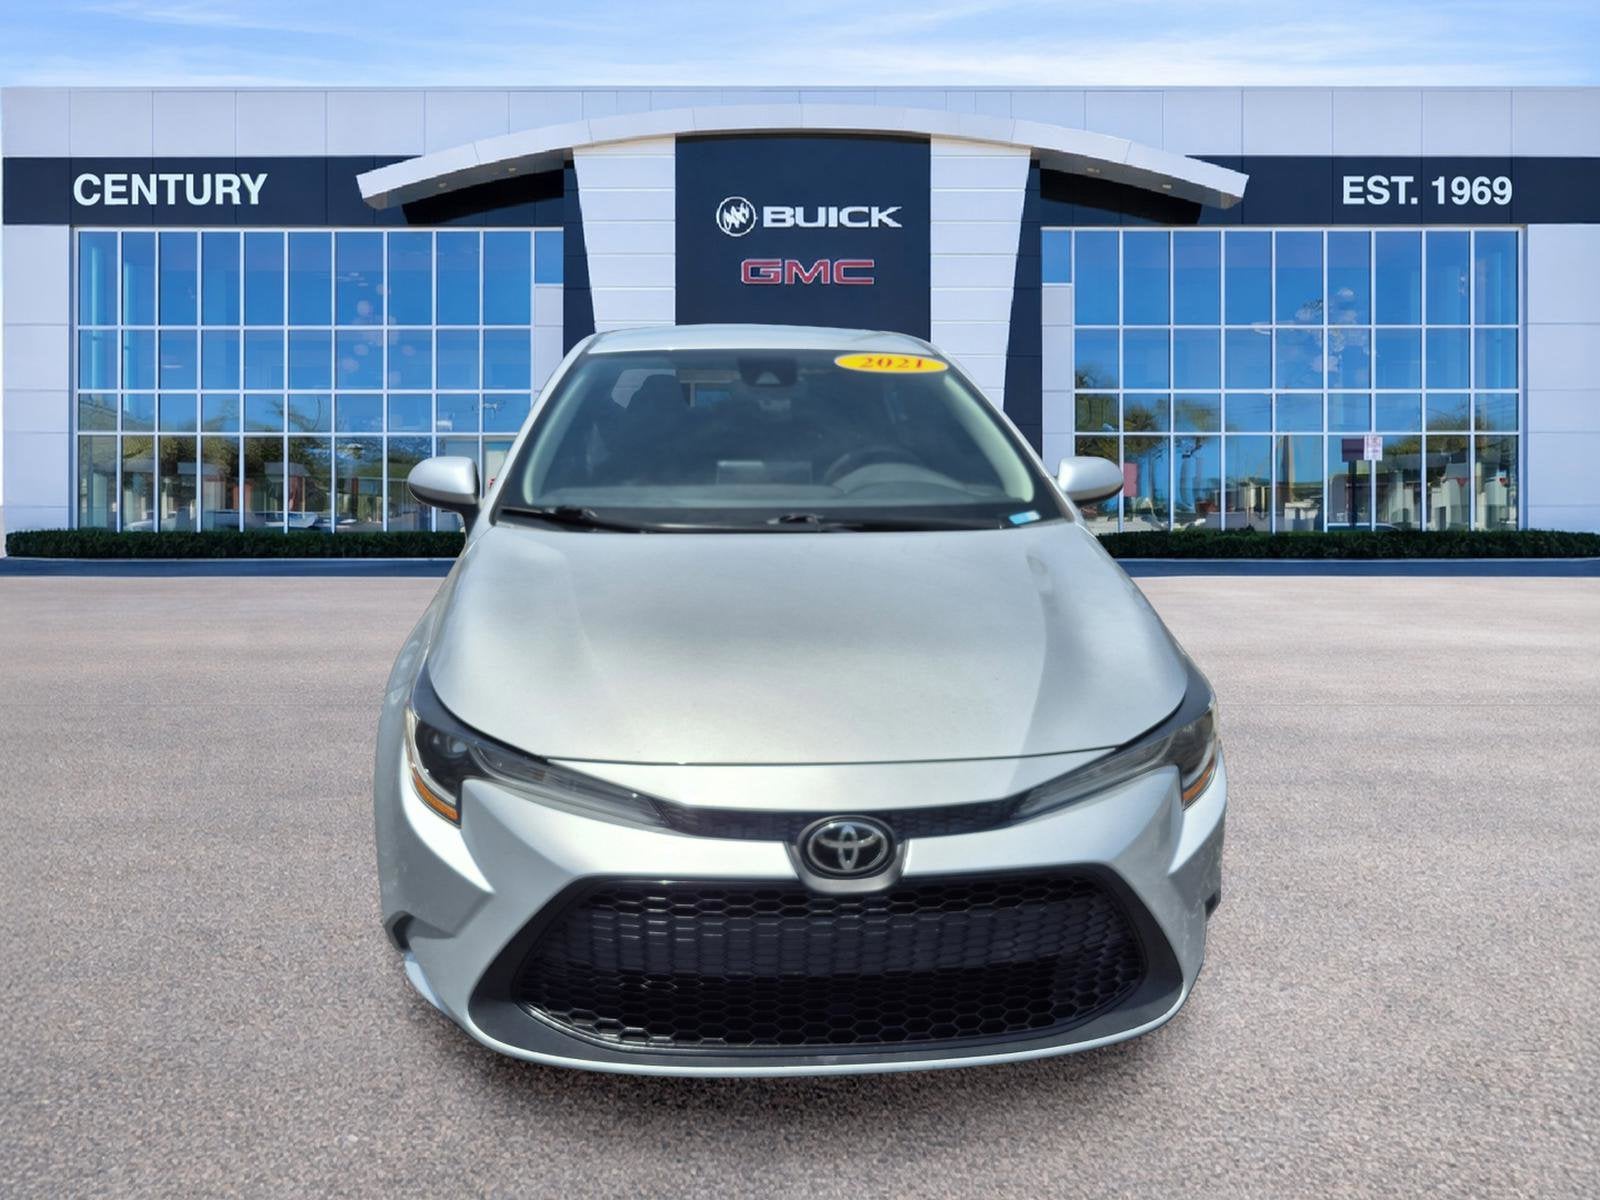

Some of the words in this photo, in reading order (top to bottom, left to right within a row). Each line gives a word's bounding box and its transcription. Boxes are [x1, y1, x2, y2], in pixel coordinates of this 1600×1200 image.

[73, 173, 268, 206] CENTURY
[1342, 175, 1419, 205] EST.
[1431, 175, 1513, 206] 1969
[763, 206, 903, 228] BUICK
[741, 258, 875, 285] GMC
[858, 356, 923, 369] 2021
